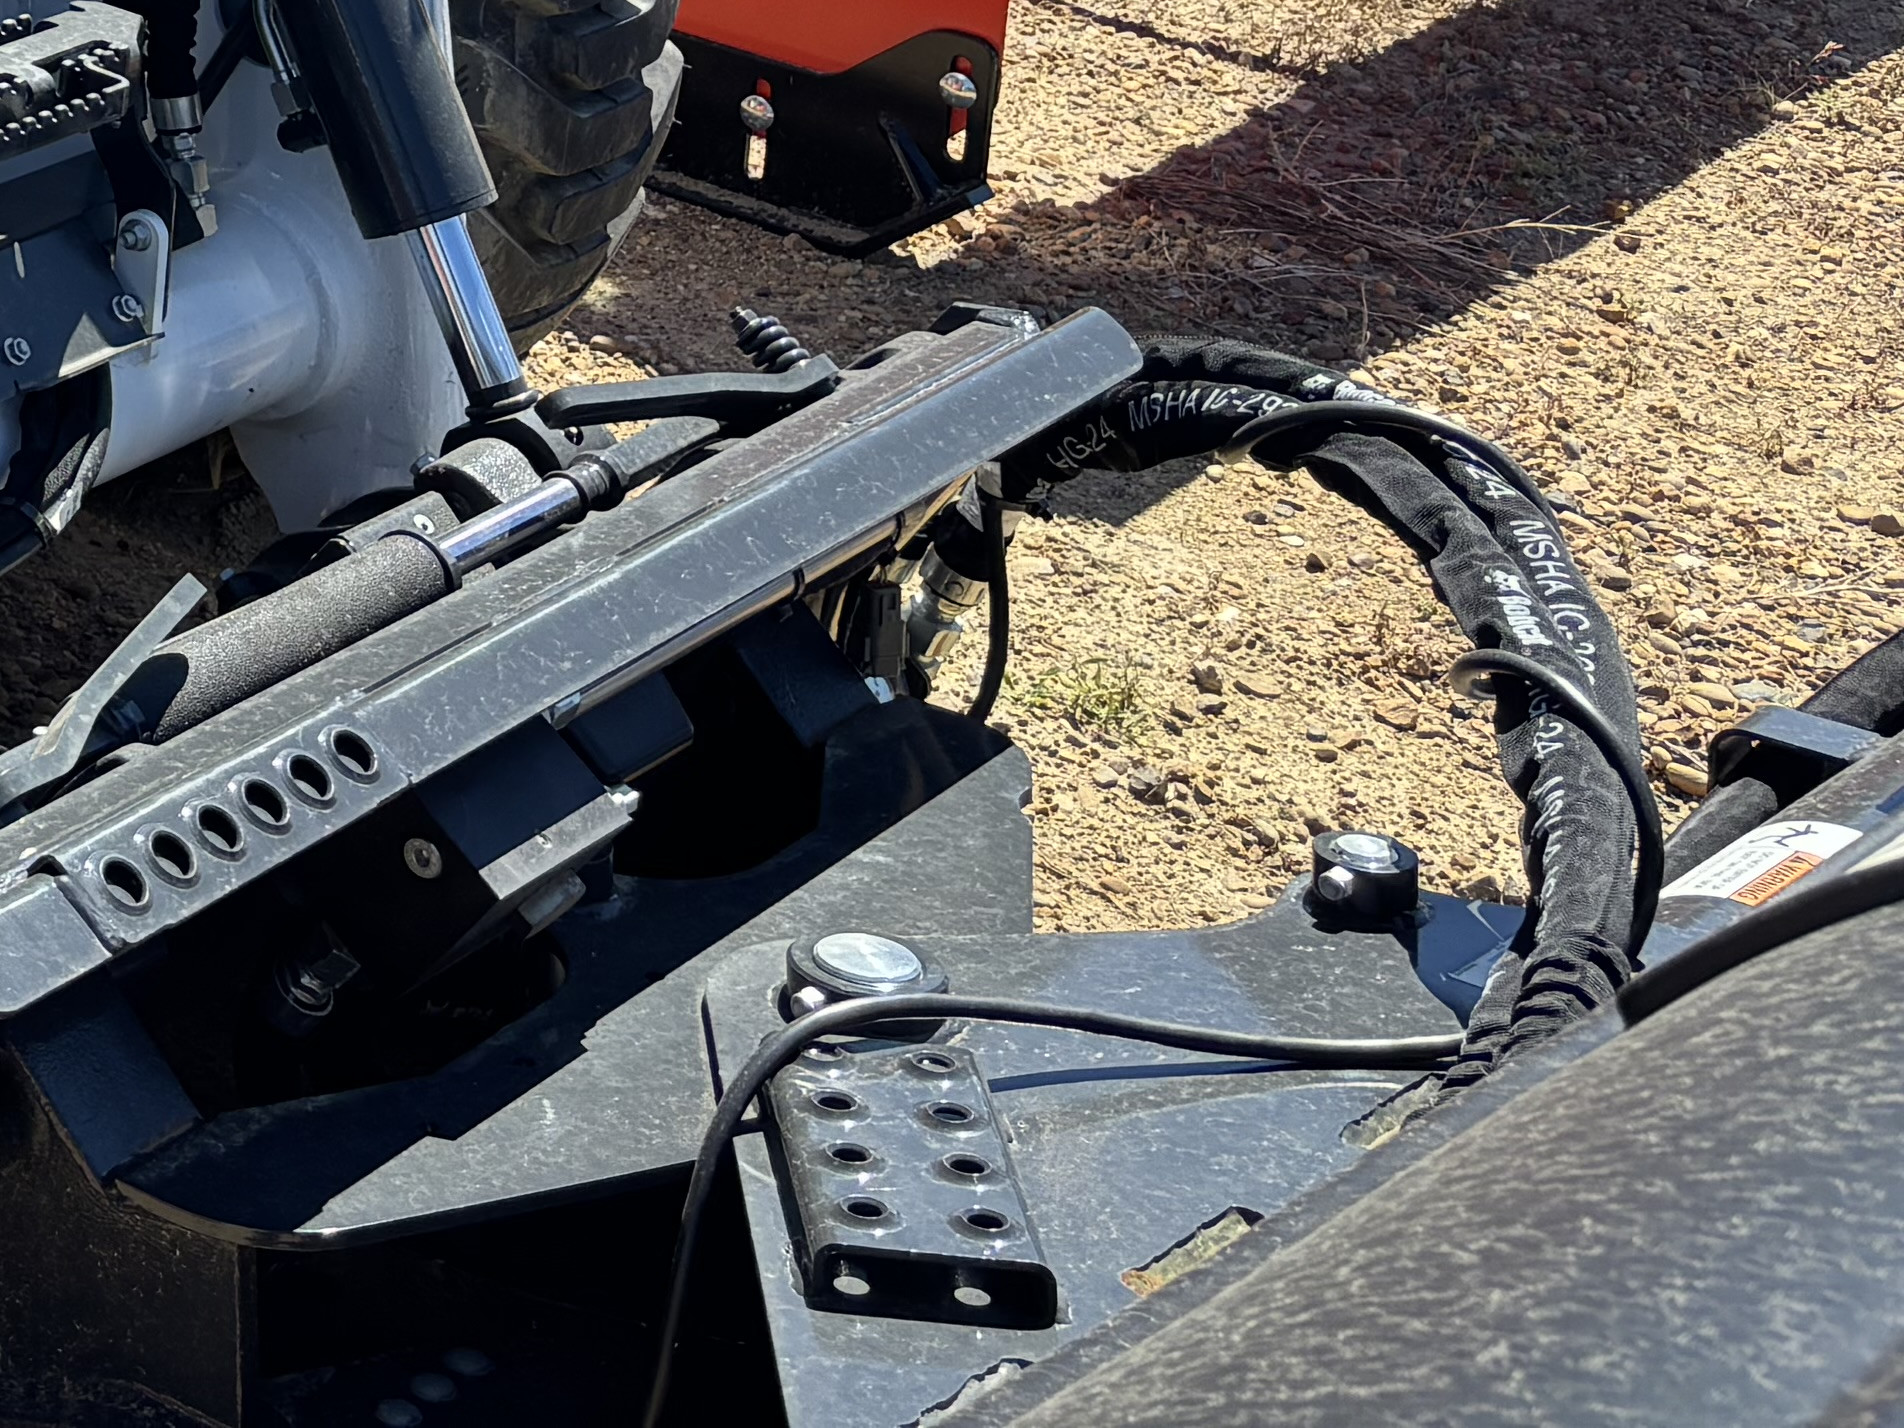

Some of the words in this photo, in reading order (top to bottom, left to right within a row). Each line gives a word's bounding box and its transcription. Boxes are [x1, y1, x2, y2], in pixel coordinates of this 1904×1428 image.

[1128, 387, 1197, 433] MSHA
[1200, 386, 1299, 418] IC-29
[1509, 519, 1578, 597] MSHA
[1738, 856, 1801, 902] WARNING
